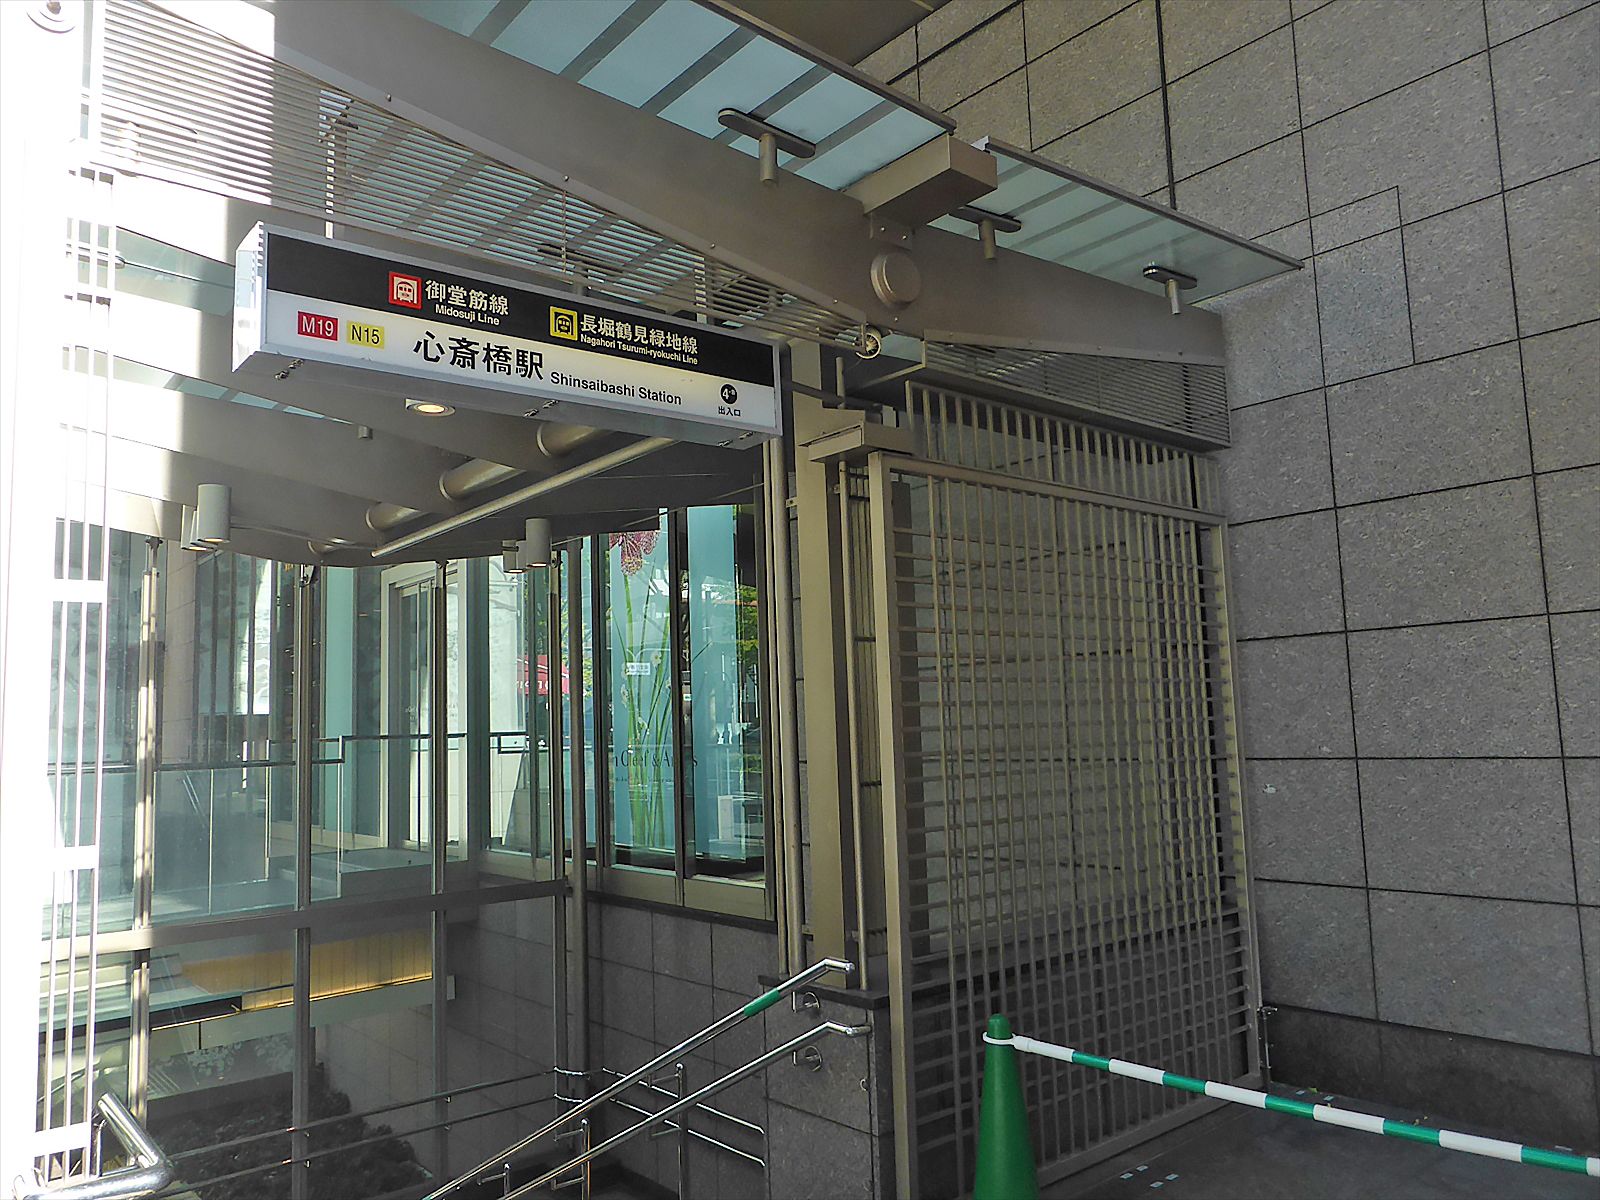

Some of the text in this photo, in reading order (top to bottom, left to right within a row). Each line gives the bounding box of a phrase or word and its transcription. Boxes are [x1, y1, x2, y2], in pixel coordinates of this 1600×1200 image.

[425, 279, 509, 316] 御堂筋線
[302, 316, 335, 338] M19
[435, 303, 500, 326] Midosuji Line
[351, 325, 380, 345] N15
[580, 314, 699, 355] 長堀鶴見緑地線
[580, 333, 699, 366] Nagahori Tsurumi-ryokuchi Line
[413, 330, 544, 381] 心斎橋駅
[550, 371, 682, 406] Shinsaibashi Station
[718, 405, 741, 418] 出入口
